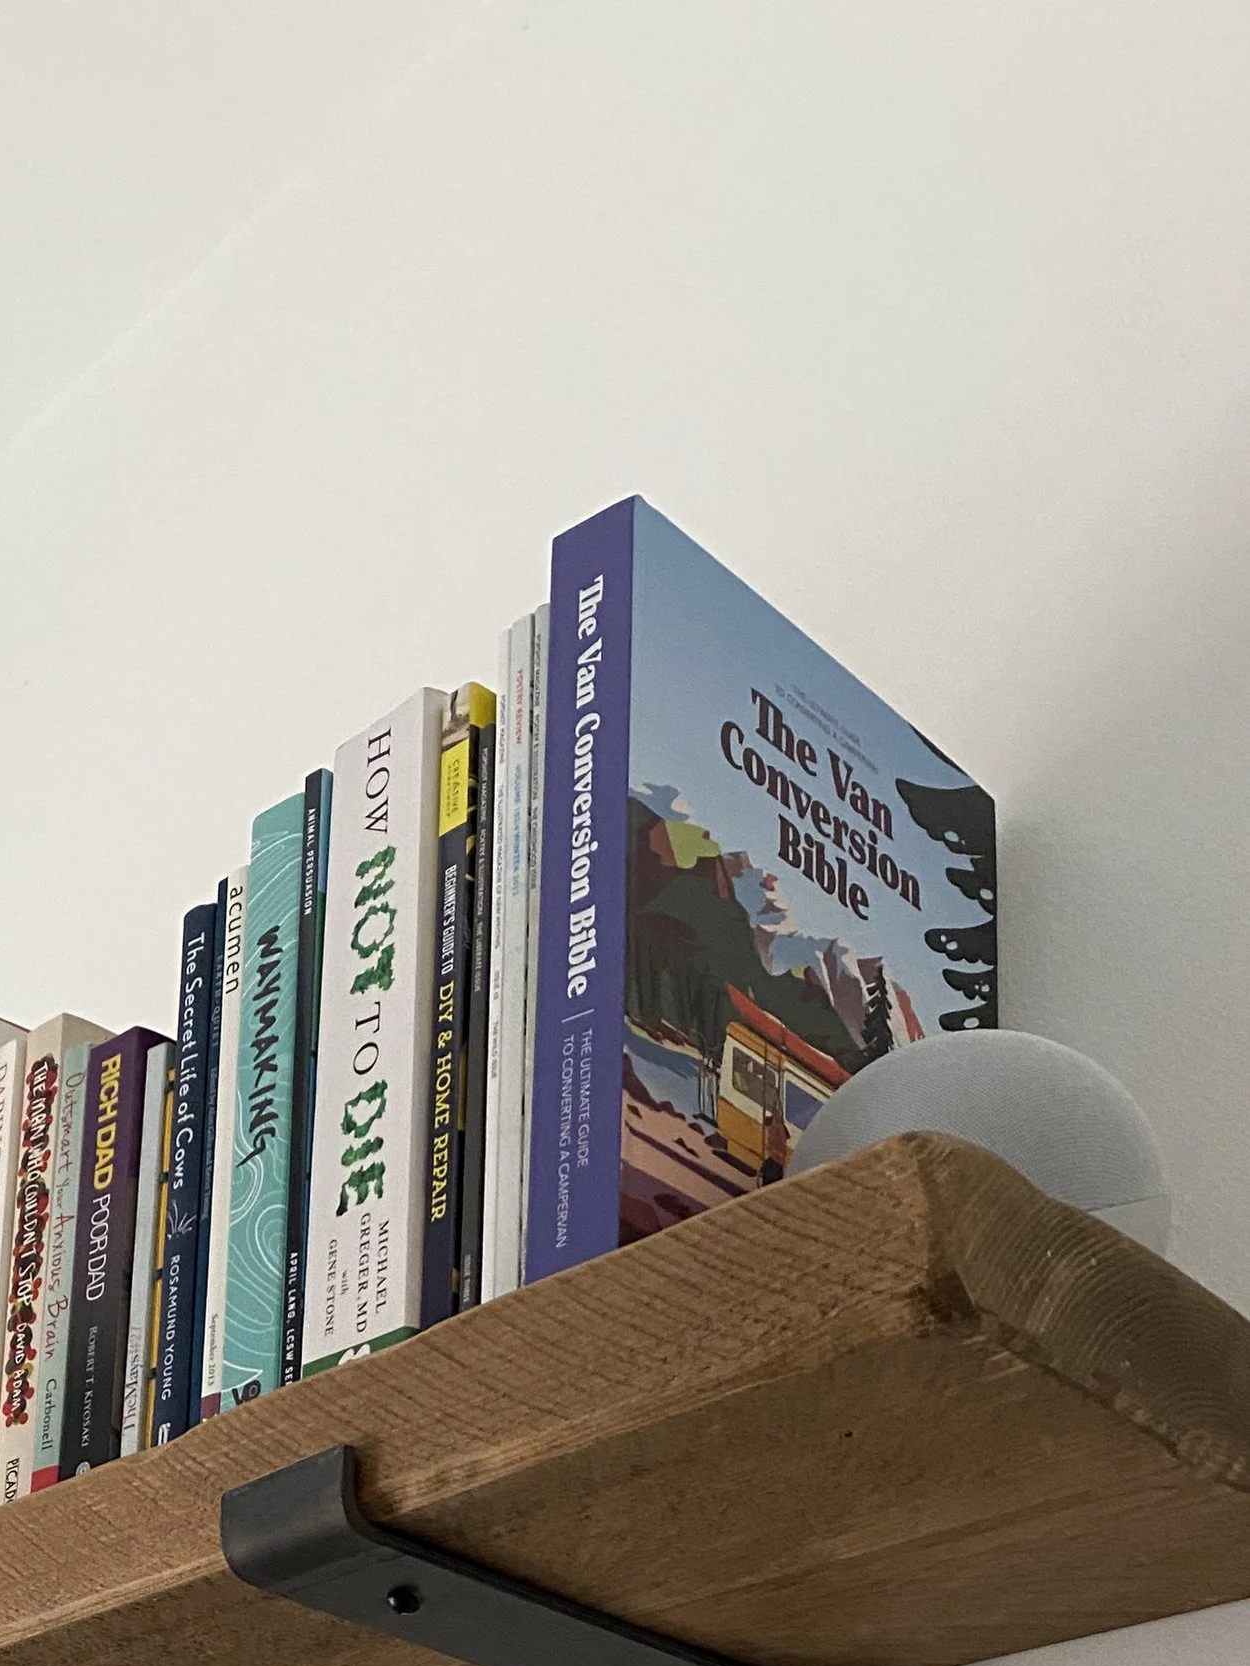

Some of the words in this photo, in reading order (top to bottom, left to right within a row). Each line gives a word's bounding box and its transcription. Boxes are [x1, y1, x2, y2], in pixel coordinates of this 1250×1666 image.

[578, 574, 604, 640] The
[576, 636, 602, 709] Van
[365, 728, 392, 834] HOW
[751, 687, 817, 777] The
[827, 747, 894, 841] Van
[306, 808, 316, 848] ANIMAL
[570, 712, 601, 904] Conversion
[720, 720, 922, 911] Conversion
[304, 849, 315, 915] PERSUASION
[443, 864, 457, 930] BEGINNER'S
[778, 813, 869, 921] Bible
[225, 885, 244, 995] acumen
[350, 844, 398, 995] NOT
[441, 924, 455, 963] GUIDE
[186, 931, 205, 975] The
[441, 958, 454, 976] TO
[567, 904, 597, 999] Bible
[181, 977, 203, 1052] Secret
[439, 980, 454, 1024] DIY
[236, 924, 283, 1169] WAYMAKING
[352, 1000, 381, 1075] TO
[438, 1030, 453, 1048] &
[562, 1034, 575, 1053] TO
[580, 1027, 593, 1055] THE
[31, 1061, 48, 1097] THE
[97, 1053, 122, 1124] RICH
[179, 1053, 199, 1097] Life
[434, 1052, 452, 1129] HOME
[559, 1056, 574, 1148] CONVERTING
[578, 1056, 592, 1123] ULTIMATE
[29, 1097, 46, 1141] MAN
[60, 1072, 85, 1175] Outsmart
[177, 1102, 195, 1125] of
[26, 1143, 44, 1182] WHO
[93, 1124, 117, 1190] DAD
[173, 1127, 194, 1190] Cows
[336, 1079, 388, 1217] DIE
[430, 1133, 449, 1222] REPAIR
[559, 1150, 570, 1162] A
[576, 1124, 590, 1168] GUIDE
[89, 1193, 111, 1257] POOR
[556, 1164, 571, 1249] CAMPERVAN
[15, 1261, 35, 1306] STOP
[48, 1213, 75, 1293] Anxious
[86, 1255, 107, 1301] DAD
[288, 1251, 299, 1287] APRIL
[326, 1239, 338, 1283] GENE
[340, 1270, 348, 1295] with
[375, 1219, 390, 1314] MICHAEL
[42, 1294, 69, 1360] Brain
[165, 1254, 181, 1341] ROSAMUND
[324, 1285, 336, 1337] STONE
[356, 1300, 369, 1334] MD
[14, 1322, 28, 1365] DAVID
[86, 1325, 99, 1371] ROBERT
[208, 1313, 218, 1362] September
[285, 1328, 296, 1361] LCSW
[161, 1343, 175, 1401] YOUNG
[284, 1366, 293, 1386] SE
[41, 1378, 57, 1451] Carbonell
[81, 1389, 94, 1446] KIYOSAKI
